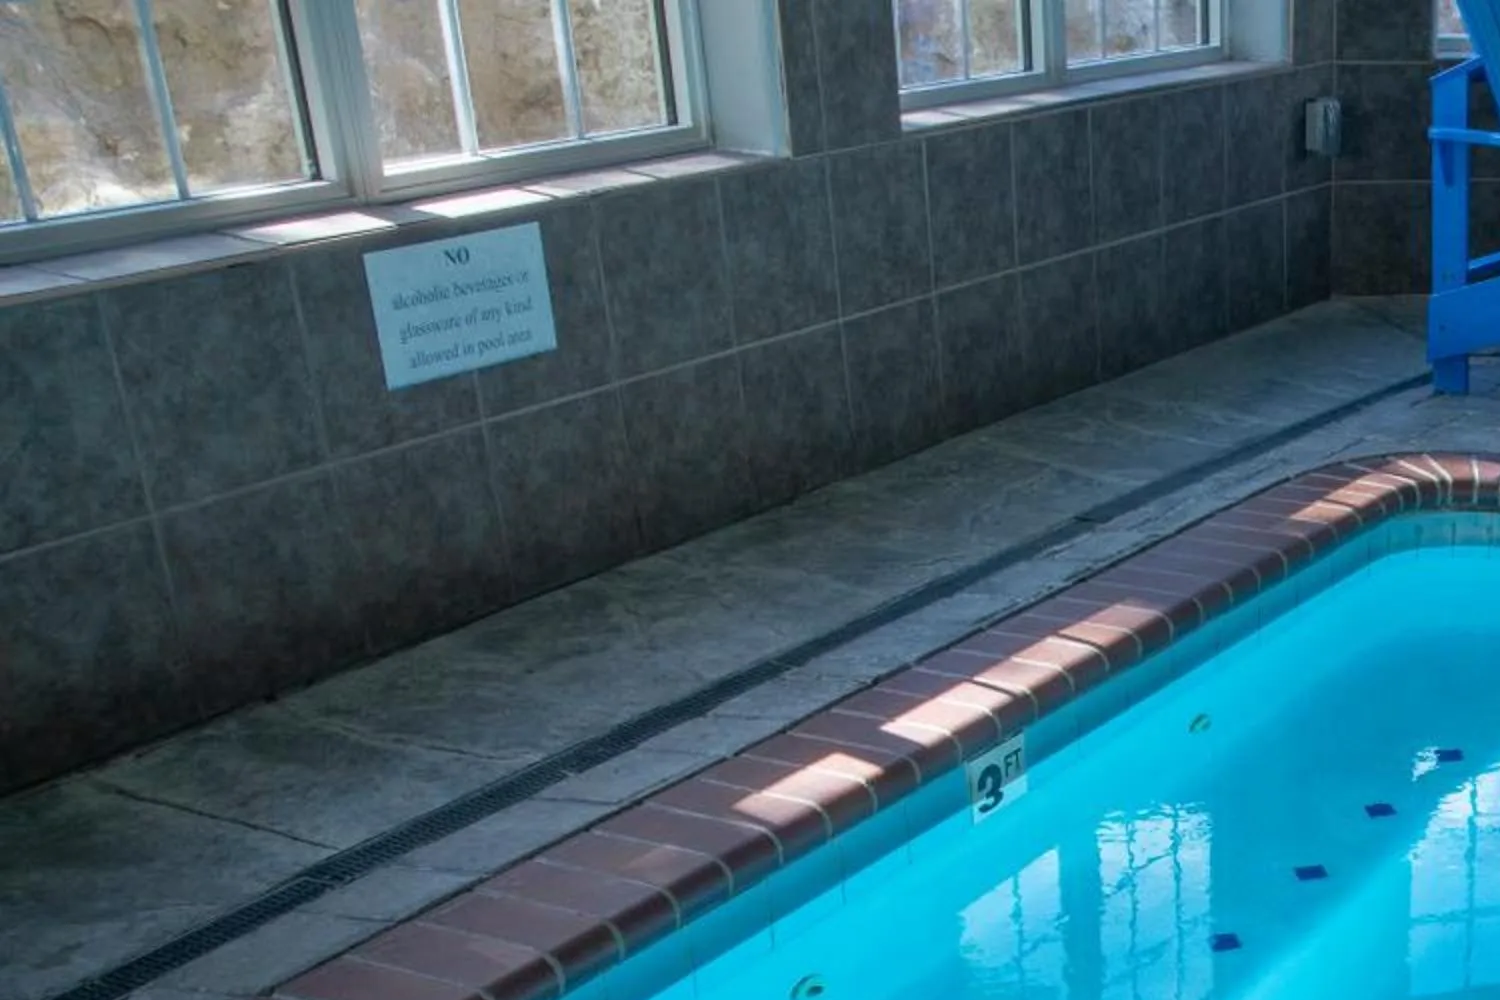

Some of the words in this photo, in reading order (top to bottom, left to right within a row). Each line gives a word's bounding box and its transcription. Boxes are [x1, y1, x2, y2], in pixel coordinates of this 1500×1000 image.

[444, 247, 470, 266] NO
[504, 295, 534, 316] kind
[410, 341, 459, 369] allowed
[463, 342, 475, 355] in
[477, 331, 505, 358] pool
[977, 763, 1004, 813] 3
[1003, 747, 1022, 778] FT
